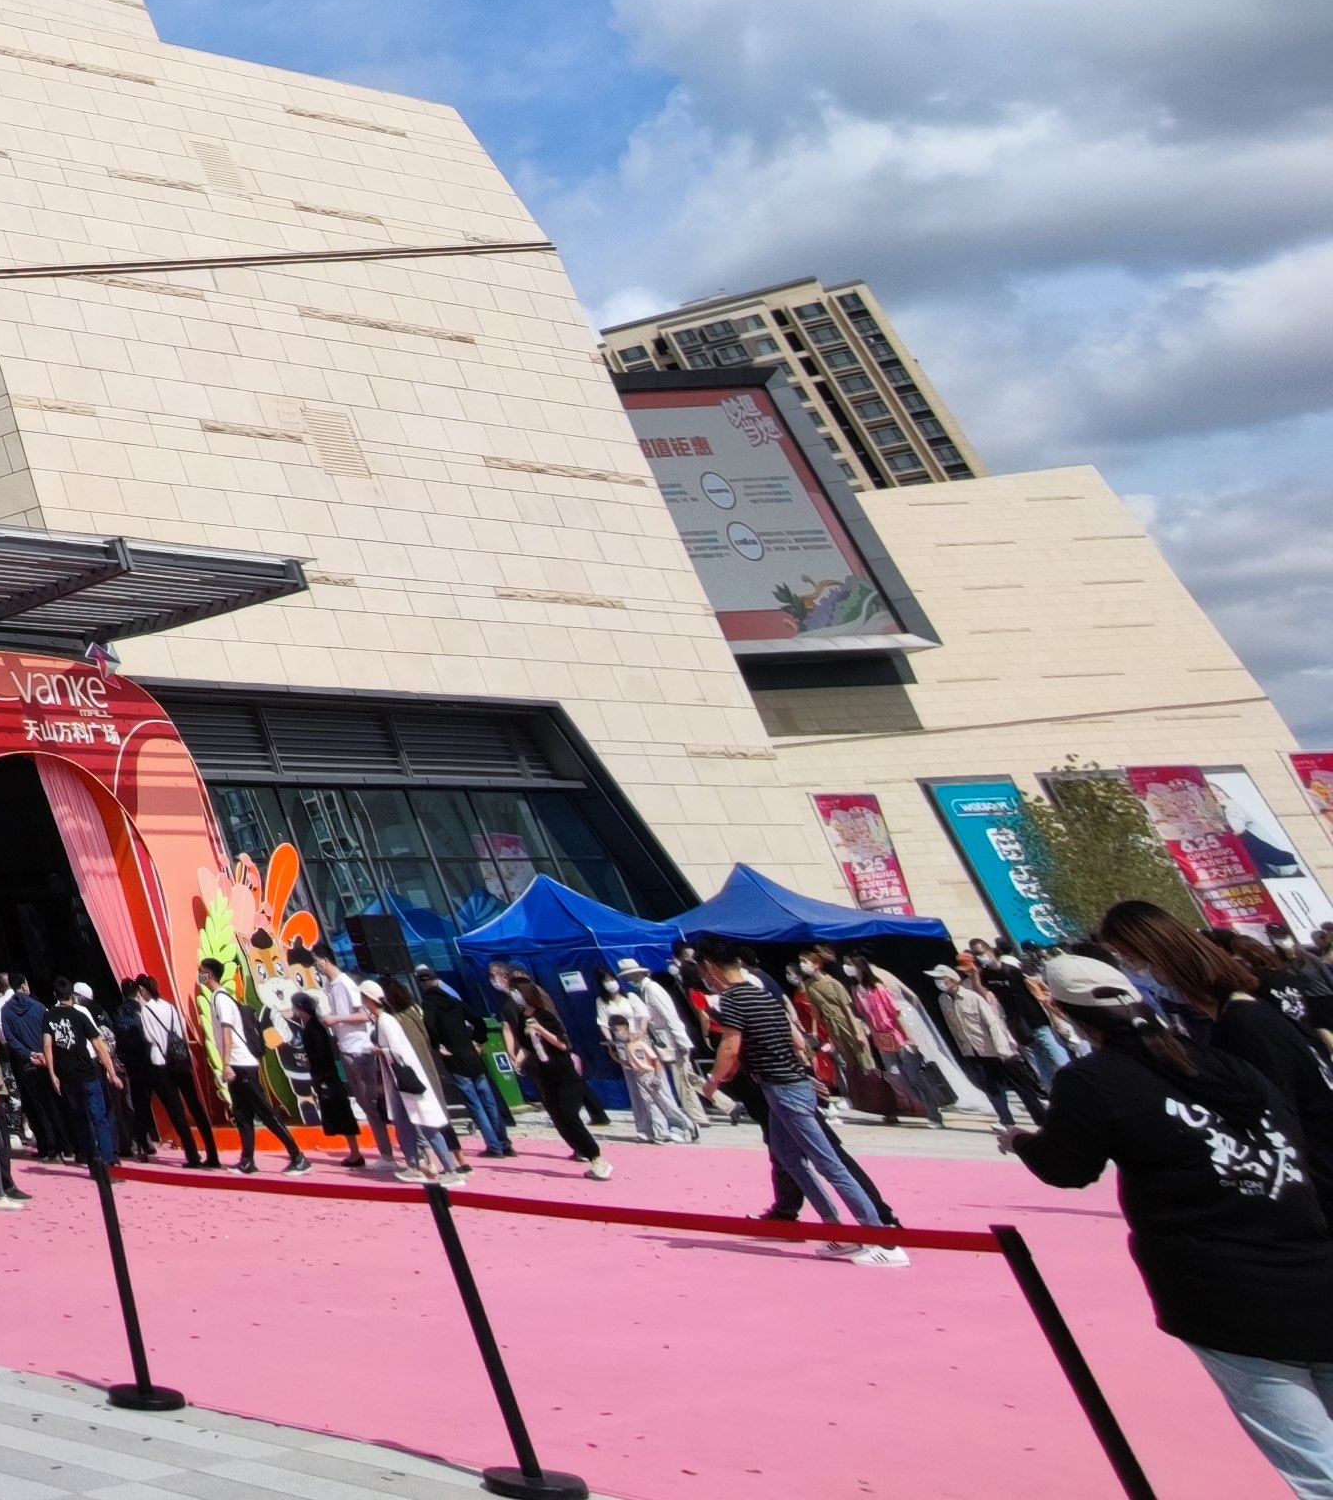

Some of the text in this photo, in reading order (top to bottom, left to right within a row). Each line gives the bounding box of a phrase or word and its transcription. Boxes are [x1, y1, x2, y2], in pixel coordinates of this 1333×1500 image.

[10, 670, 109, 709] vanke
[22, 719, 121, 746] 天山万科广场
